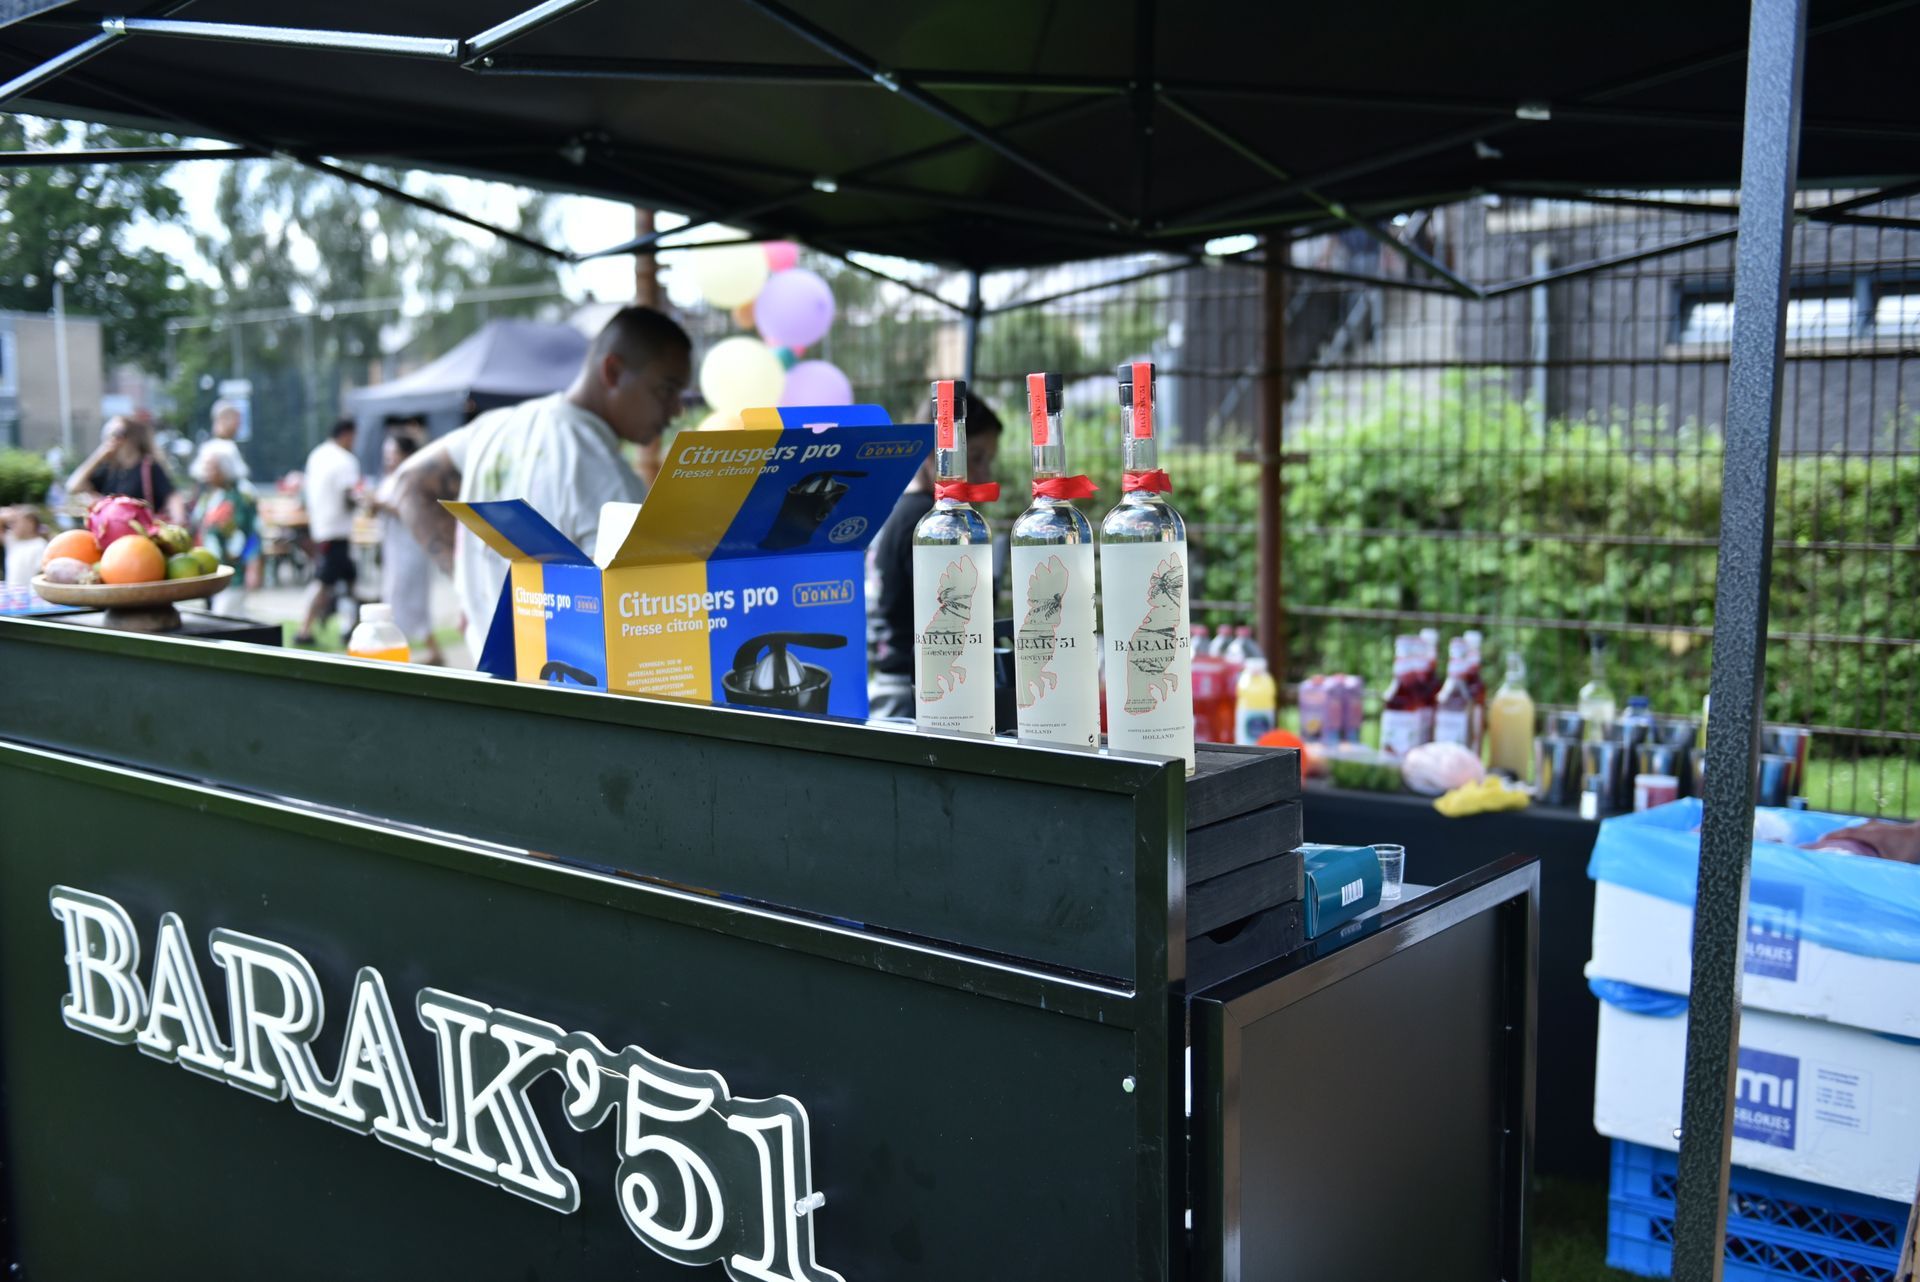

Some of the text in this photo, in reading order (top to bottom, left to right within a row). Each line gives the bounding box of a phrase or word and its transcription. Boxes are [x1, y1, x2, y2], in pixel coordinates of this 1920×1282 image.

[678, 442, 842, 466] Citruspers pro
[672, 464, 780, 479] Presse citron pro
[515, 587, 571, 611] Citruspers pro
[619, 586, 779, 618] Citruspers pro
[545, 610, 554, 620] pro
[622, 616, 728, 637] Presse citron pro
[1115, 637, 1189, 652] BARAK'51
[51, 891, 818, 1282] BARAK'51
[1735, 1106, 1791, 1131] BLOKJES
